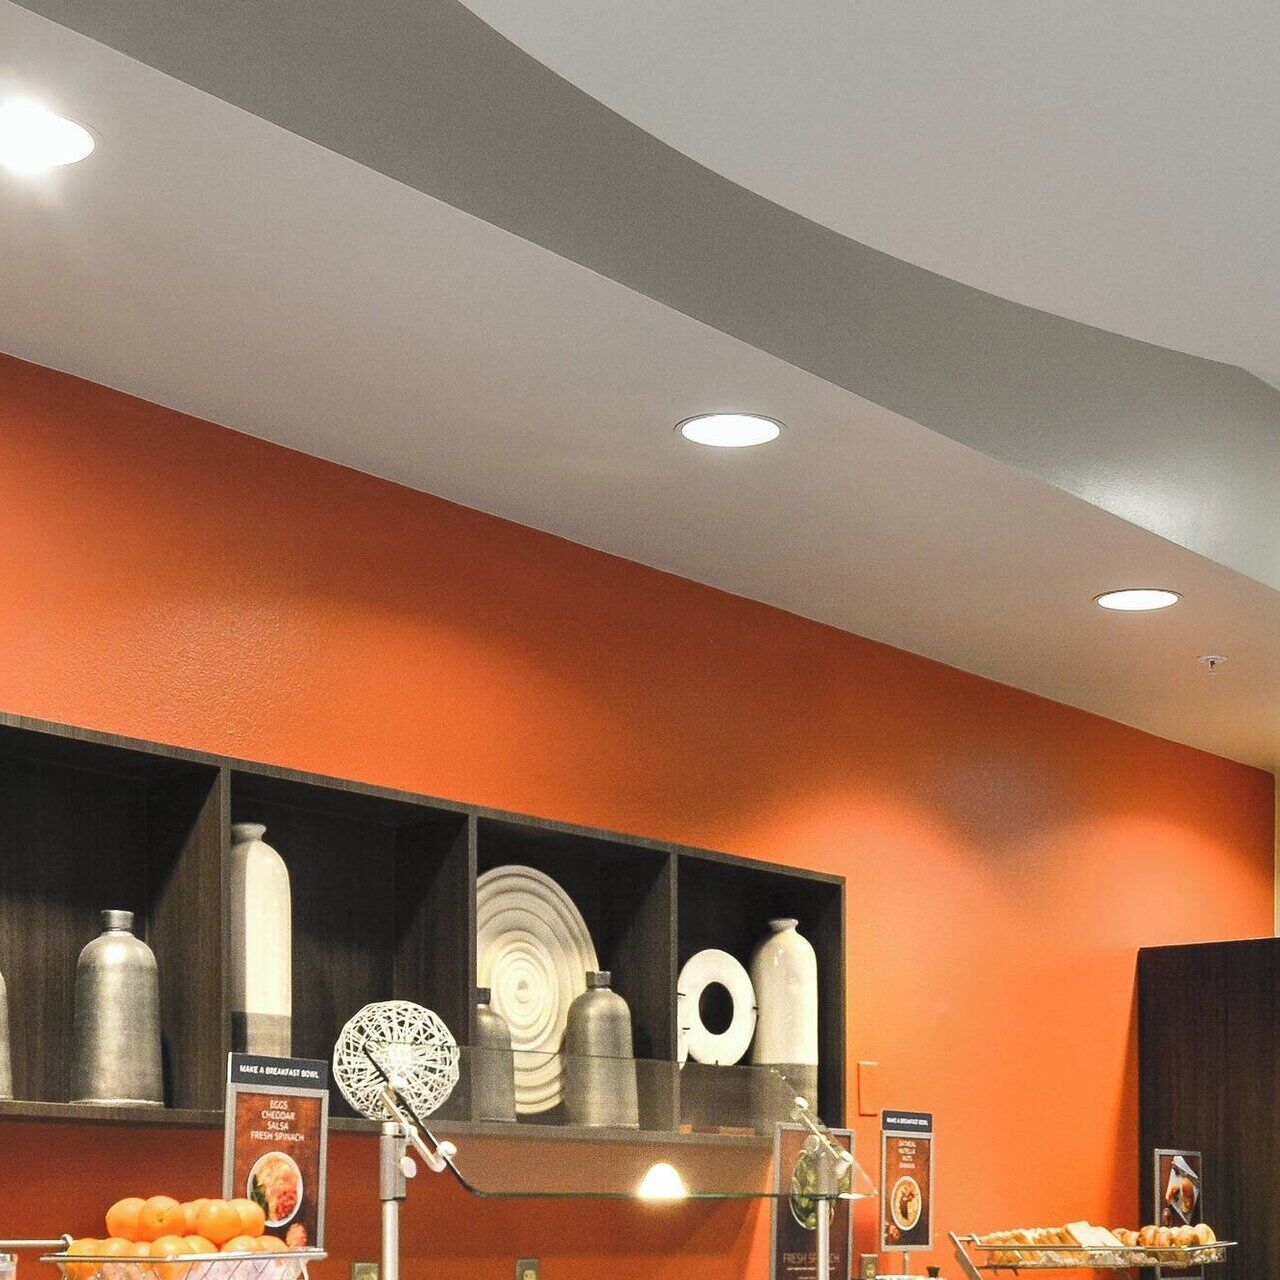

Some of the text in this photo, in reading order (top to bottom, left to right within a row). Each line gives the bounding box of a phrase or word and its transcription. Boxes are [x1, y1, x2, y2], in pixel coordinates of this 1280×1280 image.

[239, 1065, 319, 1078] MAKE A BREAKFAST BOWL
[269, 1100, 288, 1109] EGGS
[261, 1110, 295, 1120] CHEDDAR
[267, 1121, 288, 1130] SALSA
[250, 1131, 304, 1141] FRESH SPINACH
